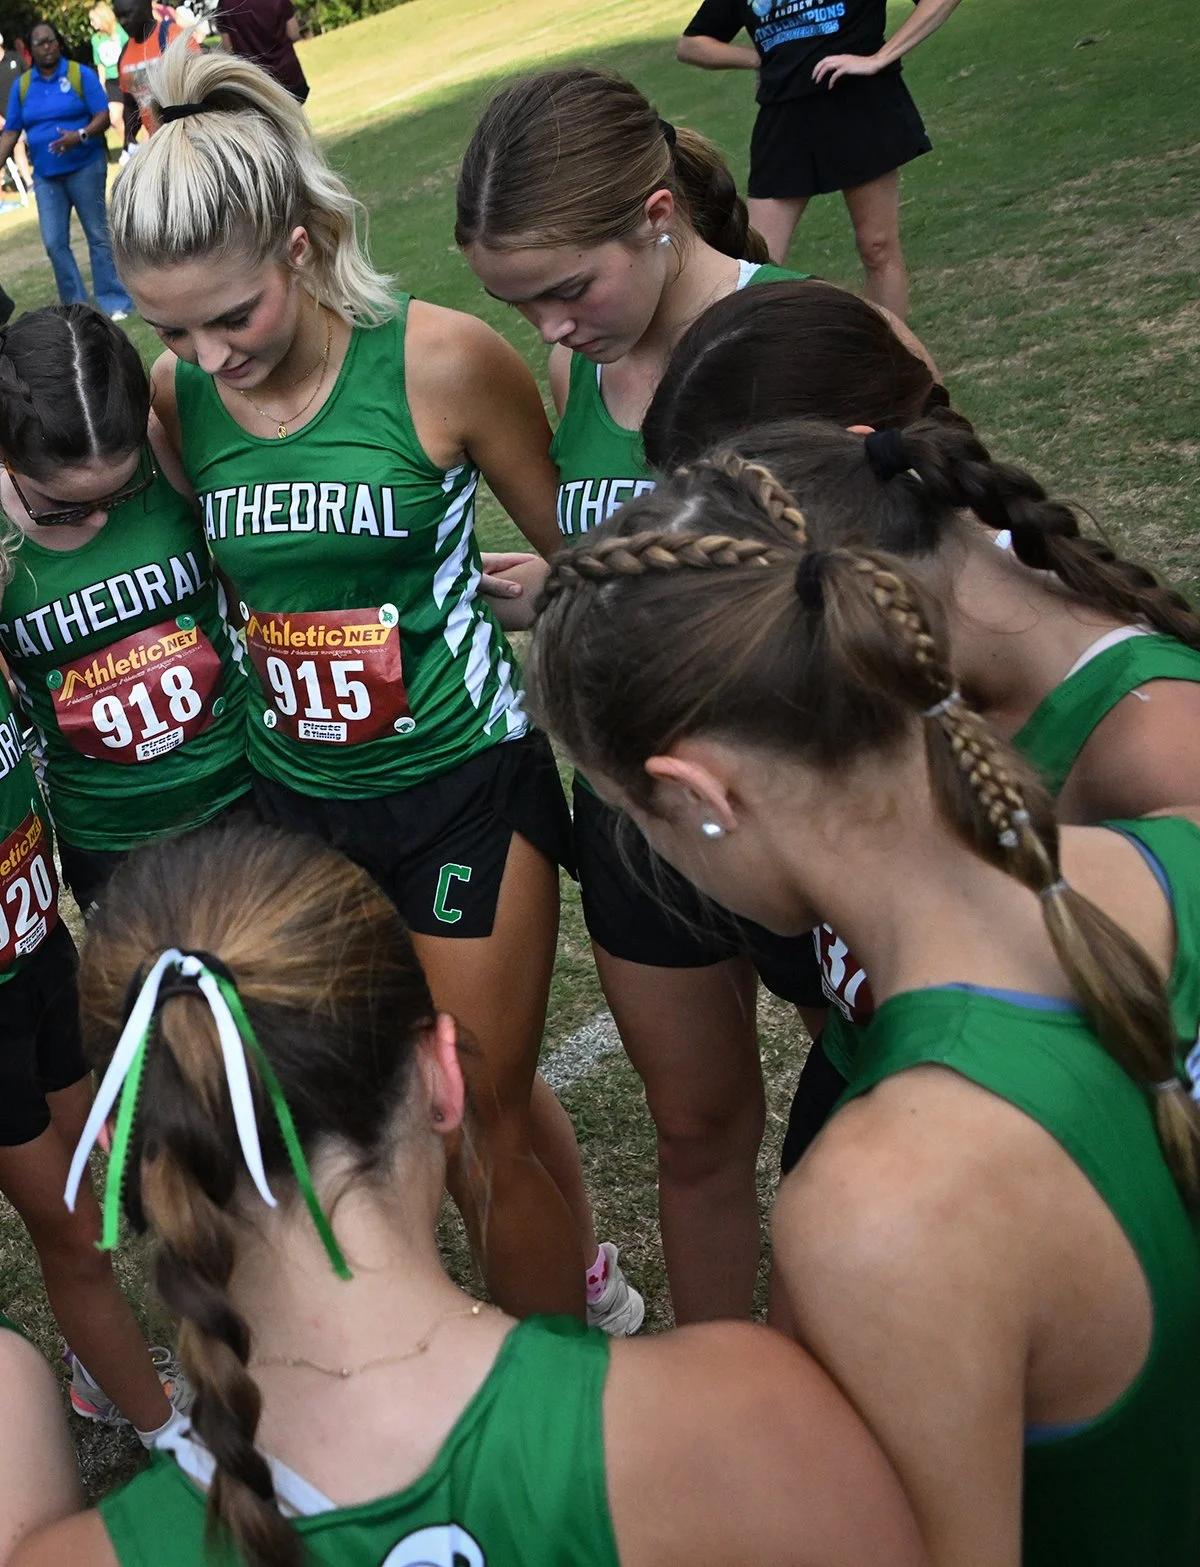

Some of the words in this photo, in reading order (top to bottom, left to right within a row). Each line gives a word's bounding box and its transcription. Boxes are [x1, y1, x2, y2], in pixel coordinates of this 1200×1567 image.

[199, 482, 409, 541] ATHEDRAL
[167, 631, 194, 652] NET
[350, 628, 385, 643] NET
[91, 665, 202, 749] 918
[266, 656, 371, 721] 915
[432, 862, 473, 924] C
